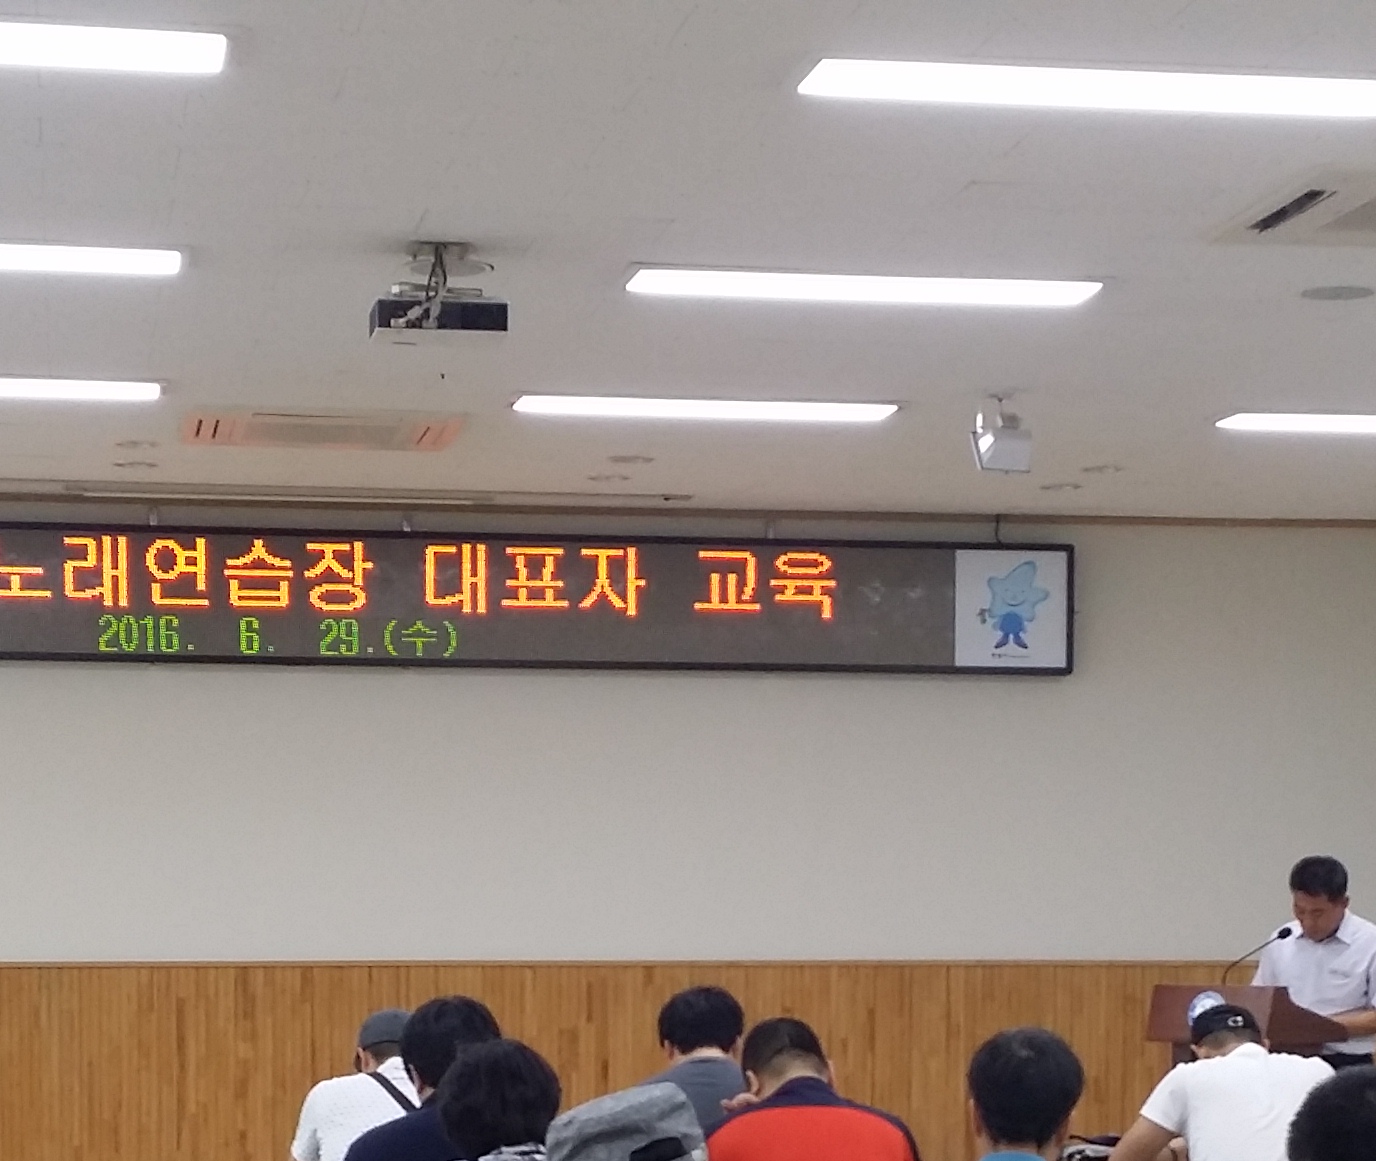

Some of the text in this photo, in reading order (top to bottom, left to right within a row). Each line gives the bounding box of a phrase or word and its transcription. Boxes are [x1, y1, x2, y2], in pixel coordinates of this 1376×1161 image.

[422, 542, 647, 619] 대표자
[693, 549, 837, 620] 교육
[97, 614, 196, 653] 2016.
[238, 615, 275, 655] 6.
